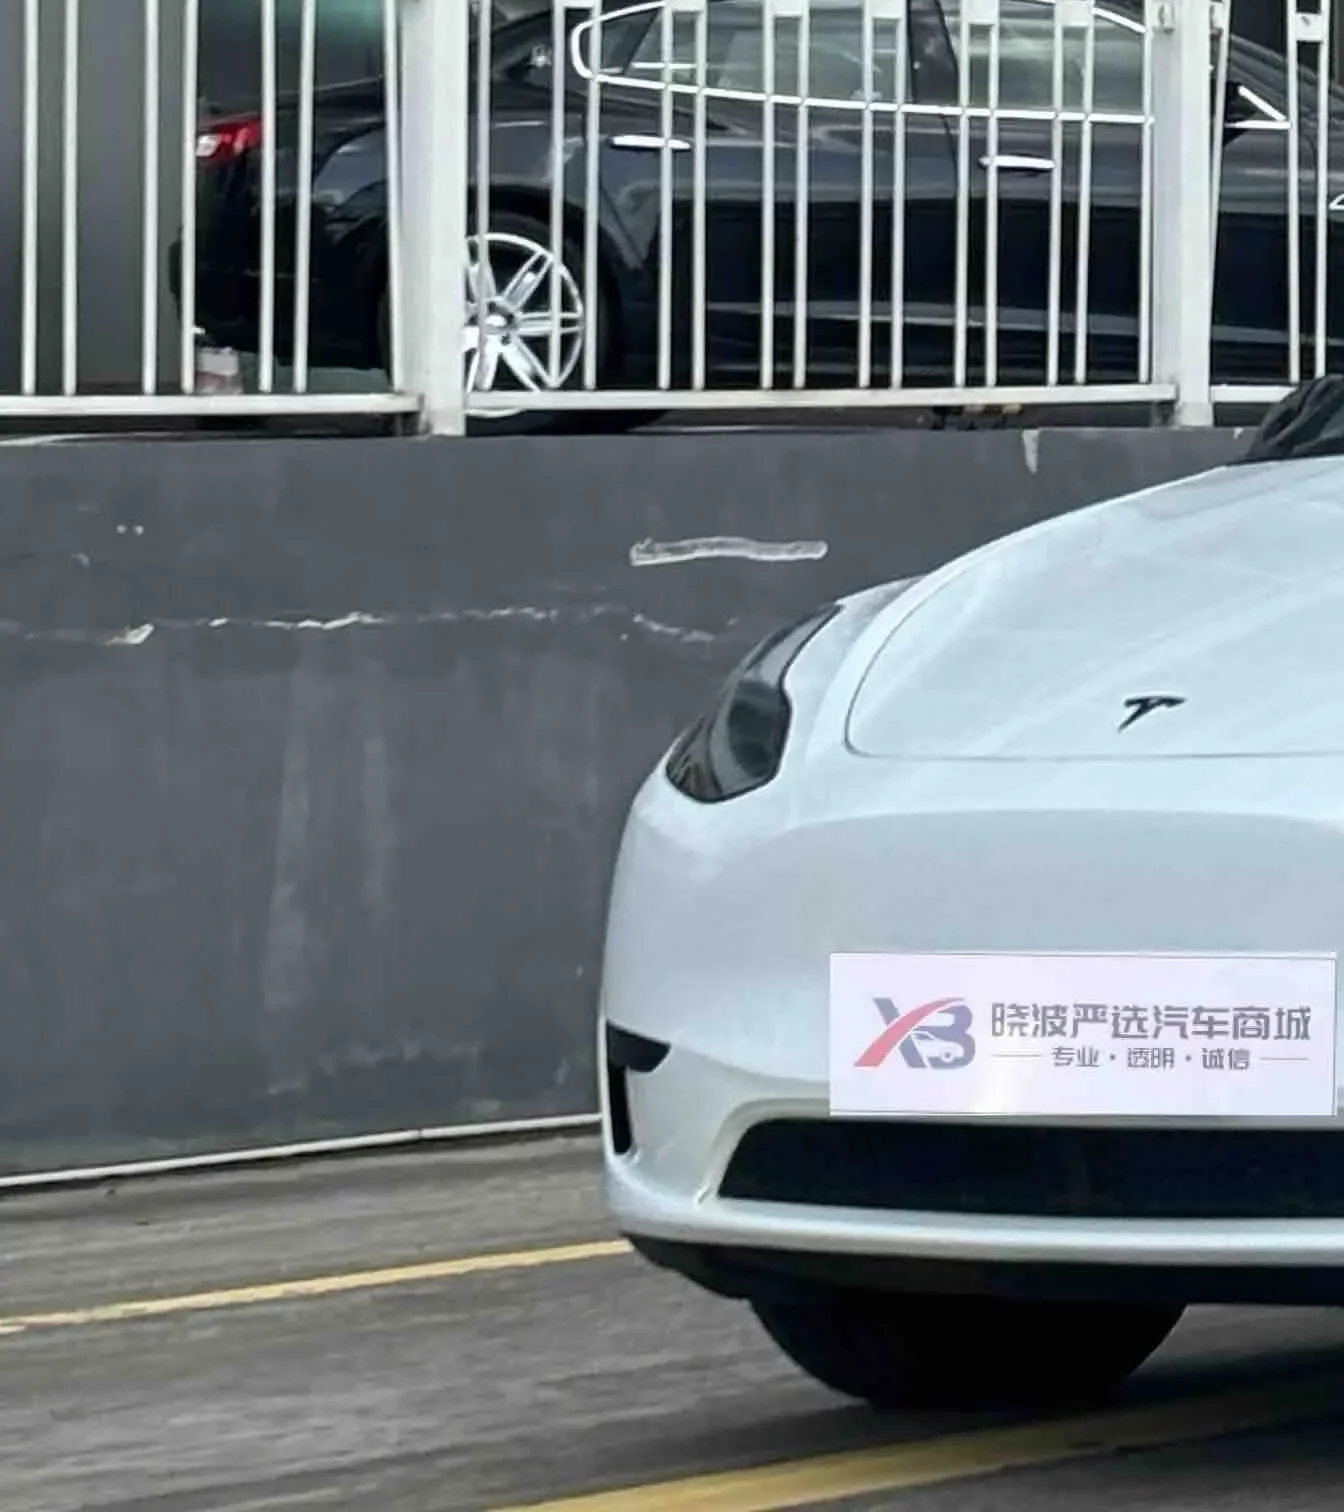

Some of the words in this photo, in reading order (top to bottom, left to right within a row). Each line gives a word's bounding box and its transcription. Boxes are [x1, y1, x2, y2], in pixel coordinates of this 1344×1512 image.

[990, 1001, 1312, 1041] 晓波严选汽车商城
